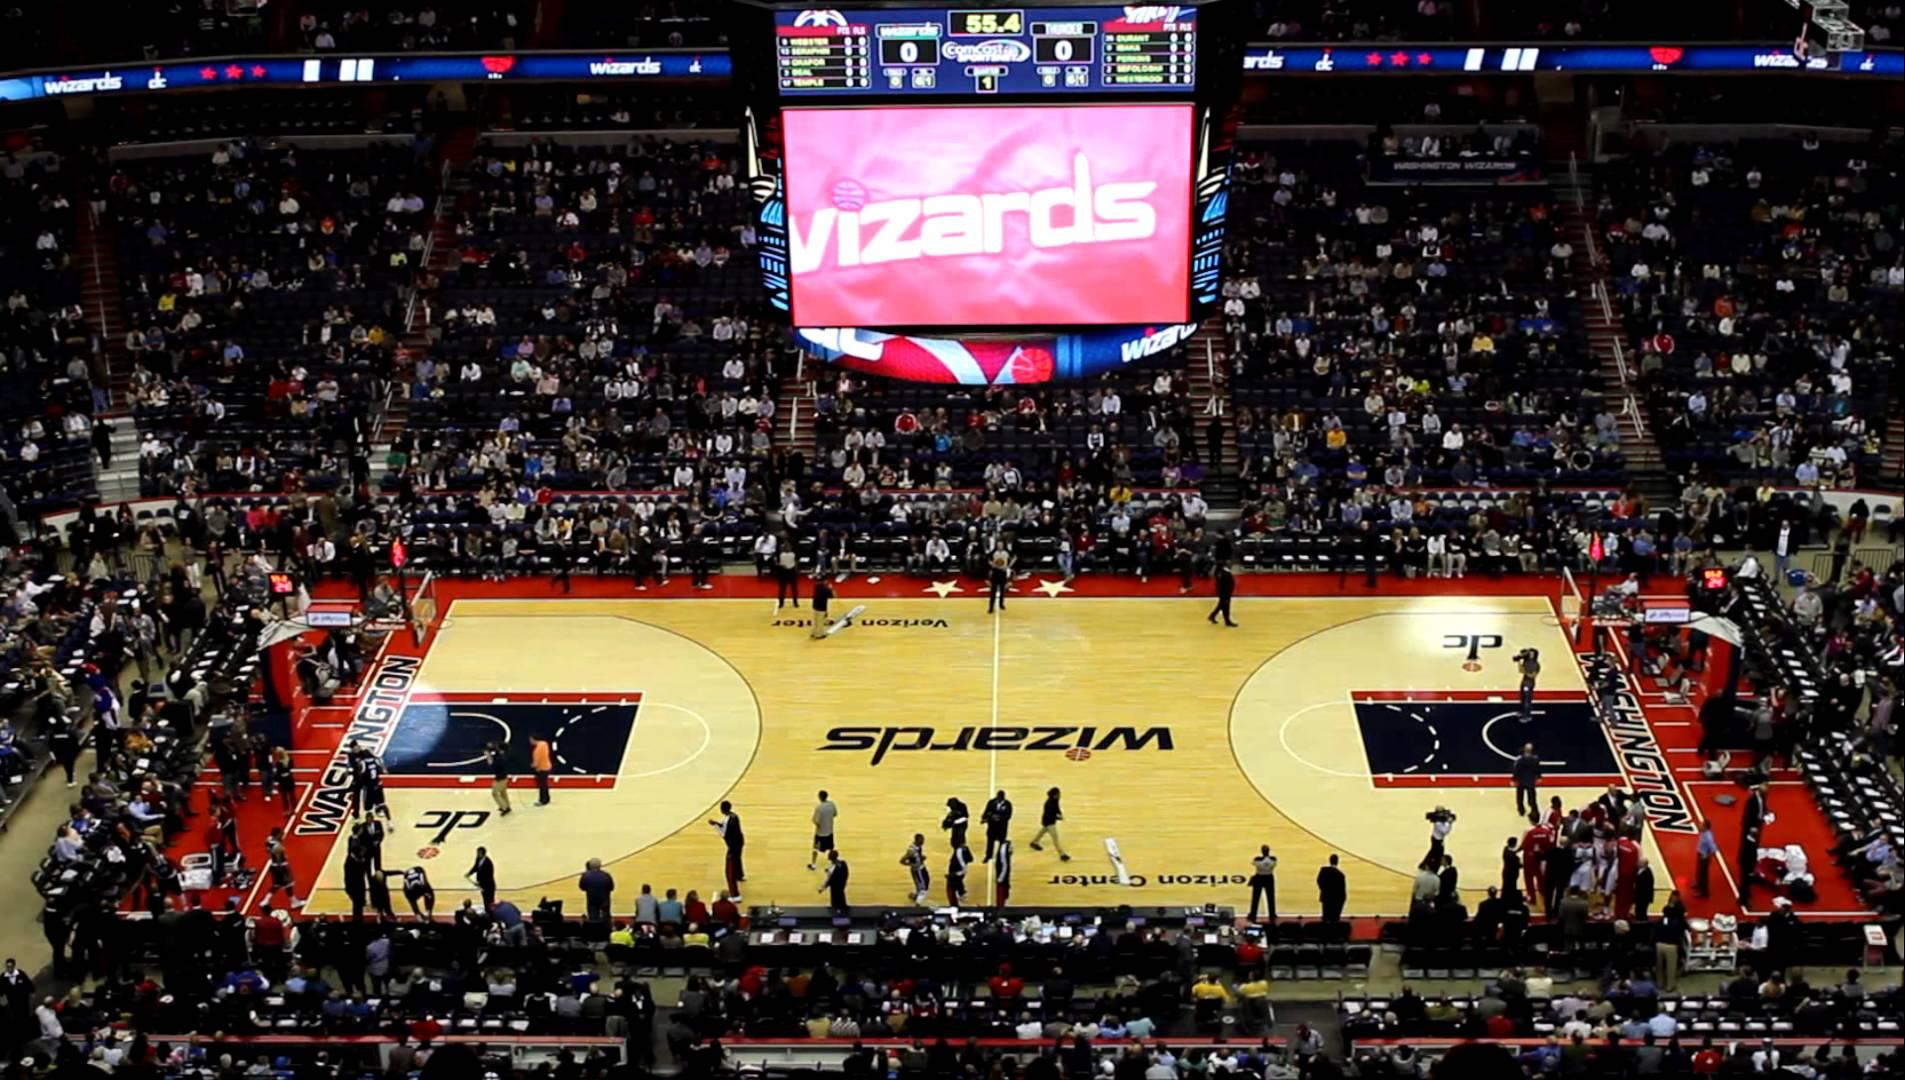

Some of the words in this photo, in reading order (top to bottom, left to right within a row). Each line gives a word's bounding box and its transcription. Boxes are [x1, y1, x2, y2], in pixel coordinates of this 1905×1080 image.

[880, 22, 938, 37] wizards
[966, 14, 1021, 33] 55.4
[844, 37, 852, 46] 0
[858, 37, 866, 46] 0
[1116, 34, 1150, 42] DURANT
[1170, 33, 1178, 42] 0
[1184, 33, 1192, 42] 0
[845, 47, 852, 56] 0
[859, 47, 866, 56] 0
[900, 42, 918, 63] 0
[941, 41, 1004, 59] Comcast
[1055, 40, 1073, 61] 0
[1170, 43, 1177, 52] 0
[1184, 43, 1192, 52] 0
[590, 56, 661, 74] wizards
[791, 58, 826, 66] OKAFOR
[845, 58, 853, 67] 0
[859, 58, 867, 67] 0
[1170, 54, 1177, 63] 0
[1184, 54, 1192, 63] 0
[1315, 53, 1334, 71] dc
[791, 68, 813, 76] BEAL
[845, 68, 853, 76] 0
[860, 68, 867, 76] 0
[1170, 64, 1177, 73] 0
[1184, 64, 1191, 73] 0
[45, 71, 122, 94] wizards
[793, 79, 824, 87] TEMPLE
[846, 78, 853, 87] 0
[860, 78, 868, 87] 0
[982, 77, 992, 90] 1
[1169, 74, 1177, 83] 0
[1183, 74, 1191, 83] 0
[1393, 162, 1461, 170] WASHINGTON
[1464, 162, 1517, 170] WIZARDS
[788, 152, 1157, 274] wizards
[861, 618, 949, 628] Verizon
[1443, 634, 1503, 660] dc
[816, 727, 1174, 766] wizards
[415, 811, 491, 843] dc
